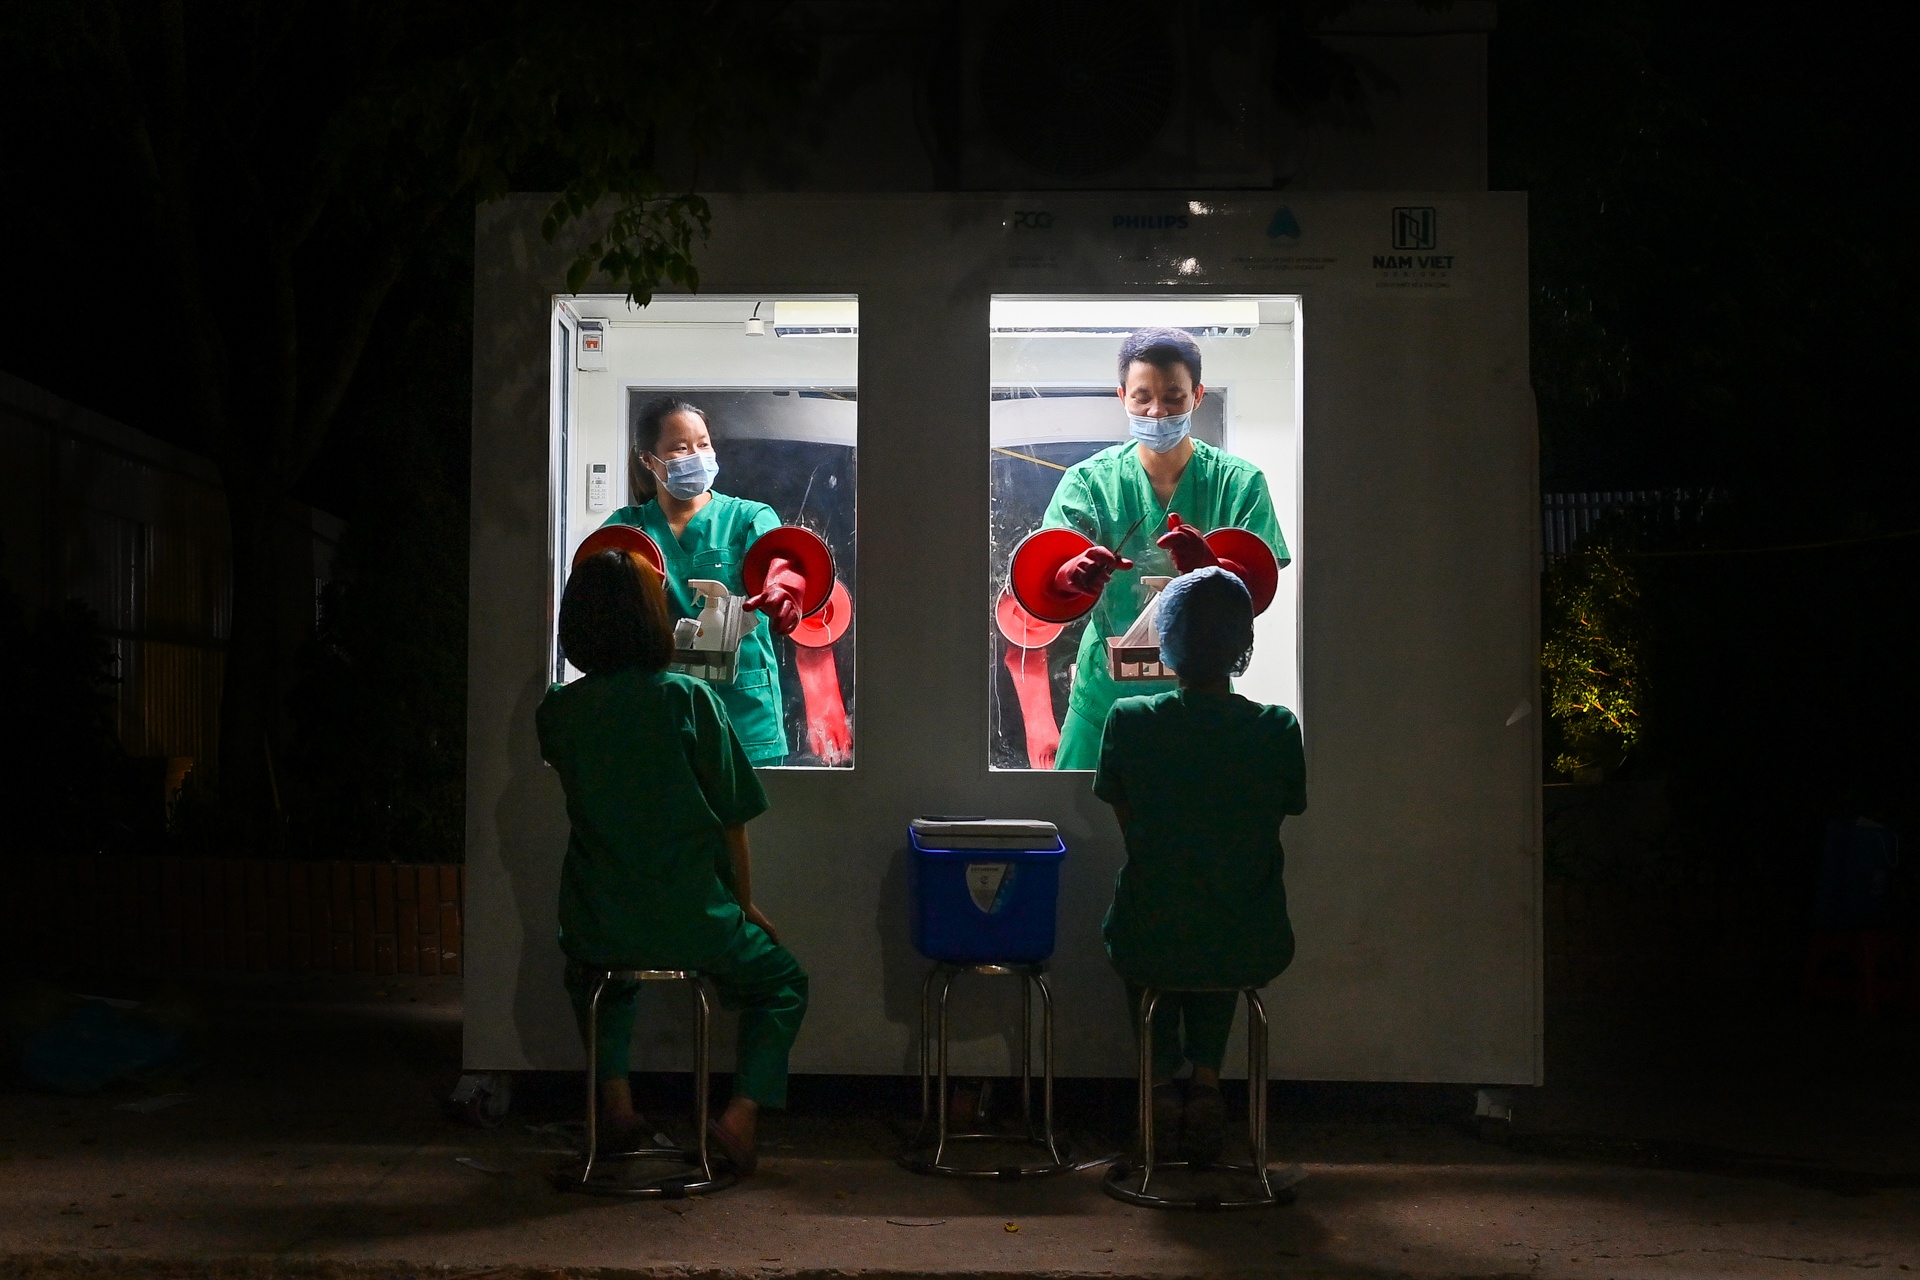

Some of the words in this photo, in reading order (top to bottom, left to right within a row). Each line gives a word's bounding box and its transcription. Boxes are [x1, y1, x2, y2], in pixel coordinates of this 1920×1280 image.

[1112, 215, 1190, 229] PHILIPS
[1372, 255, 1413, 269] NAM
[1417, 255, 1455, 269] VIET
